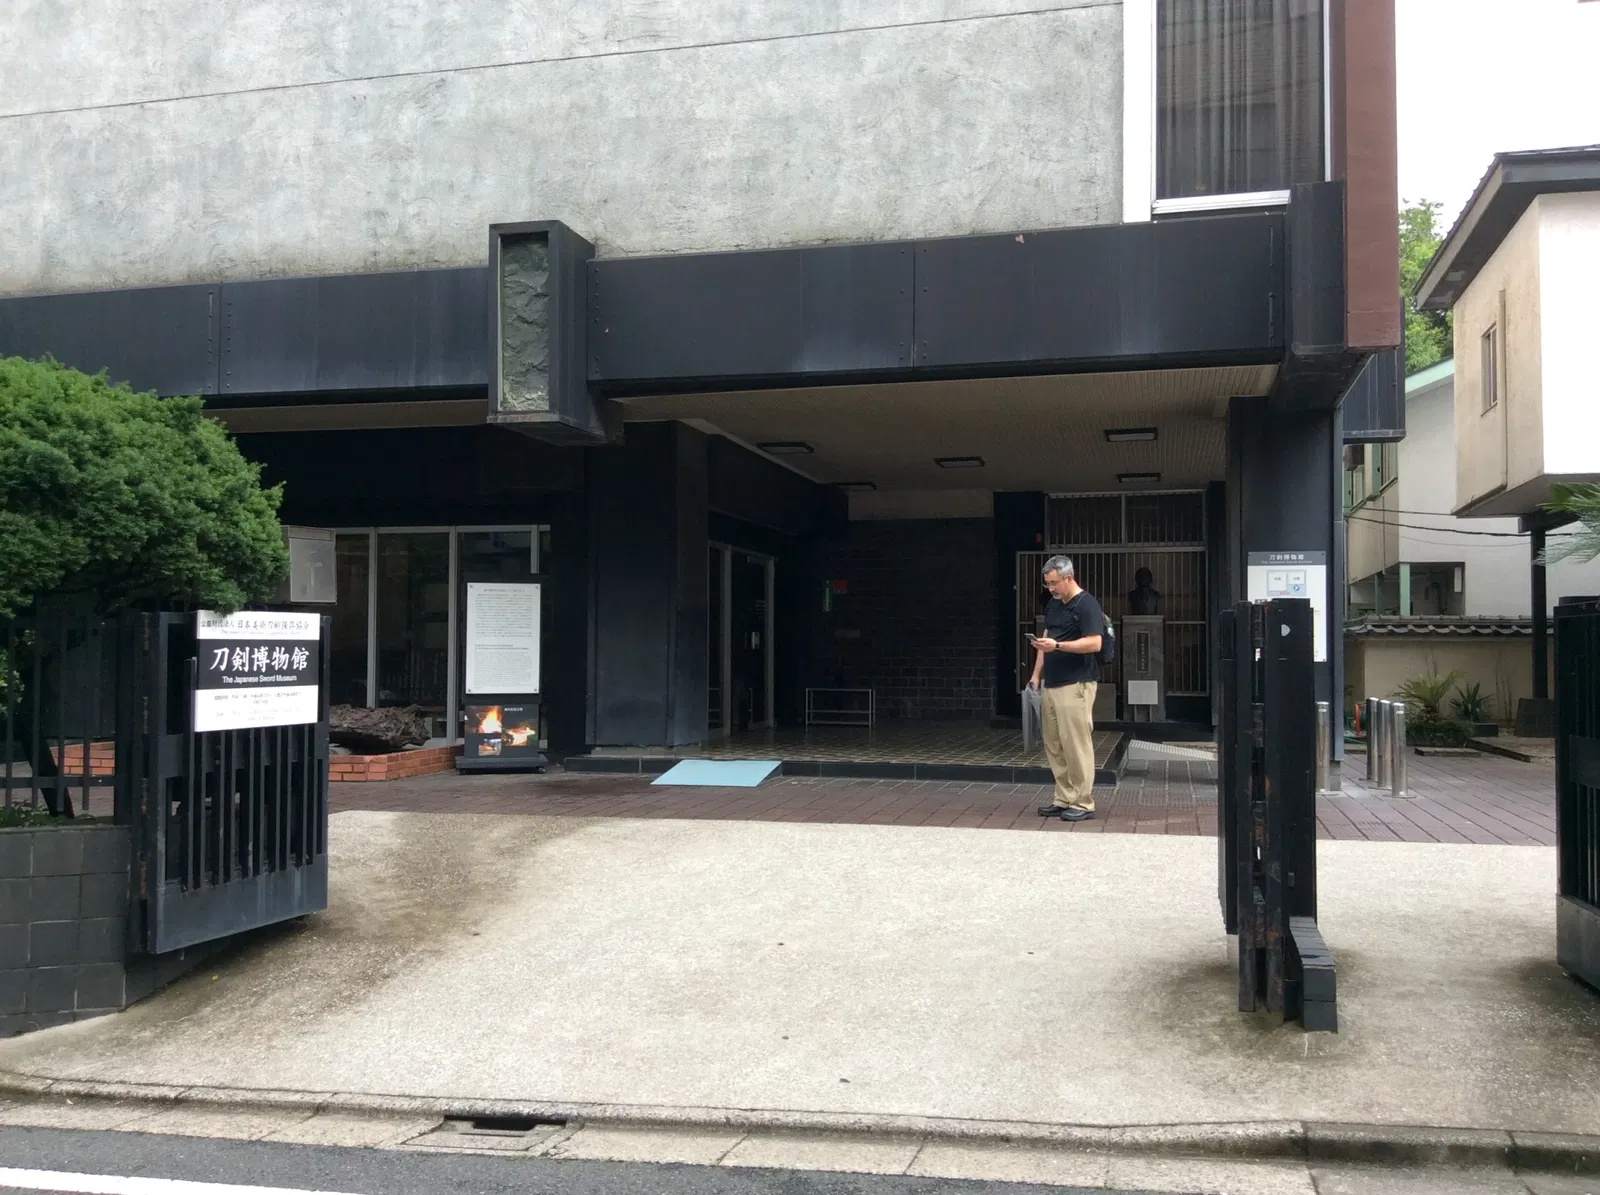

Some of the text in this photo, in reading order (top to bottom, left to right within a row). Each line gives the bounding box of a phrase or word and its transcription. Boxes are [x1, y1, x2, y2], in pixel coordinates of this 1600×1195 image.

[210, 646, 309, 672] 刀剣博物館
[234, 676, 258, 684] Japanese
